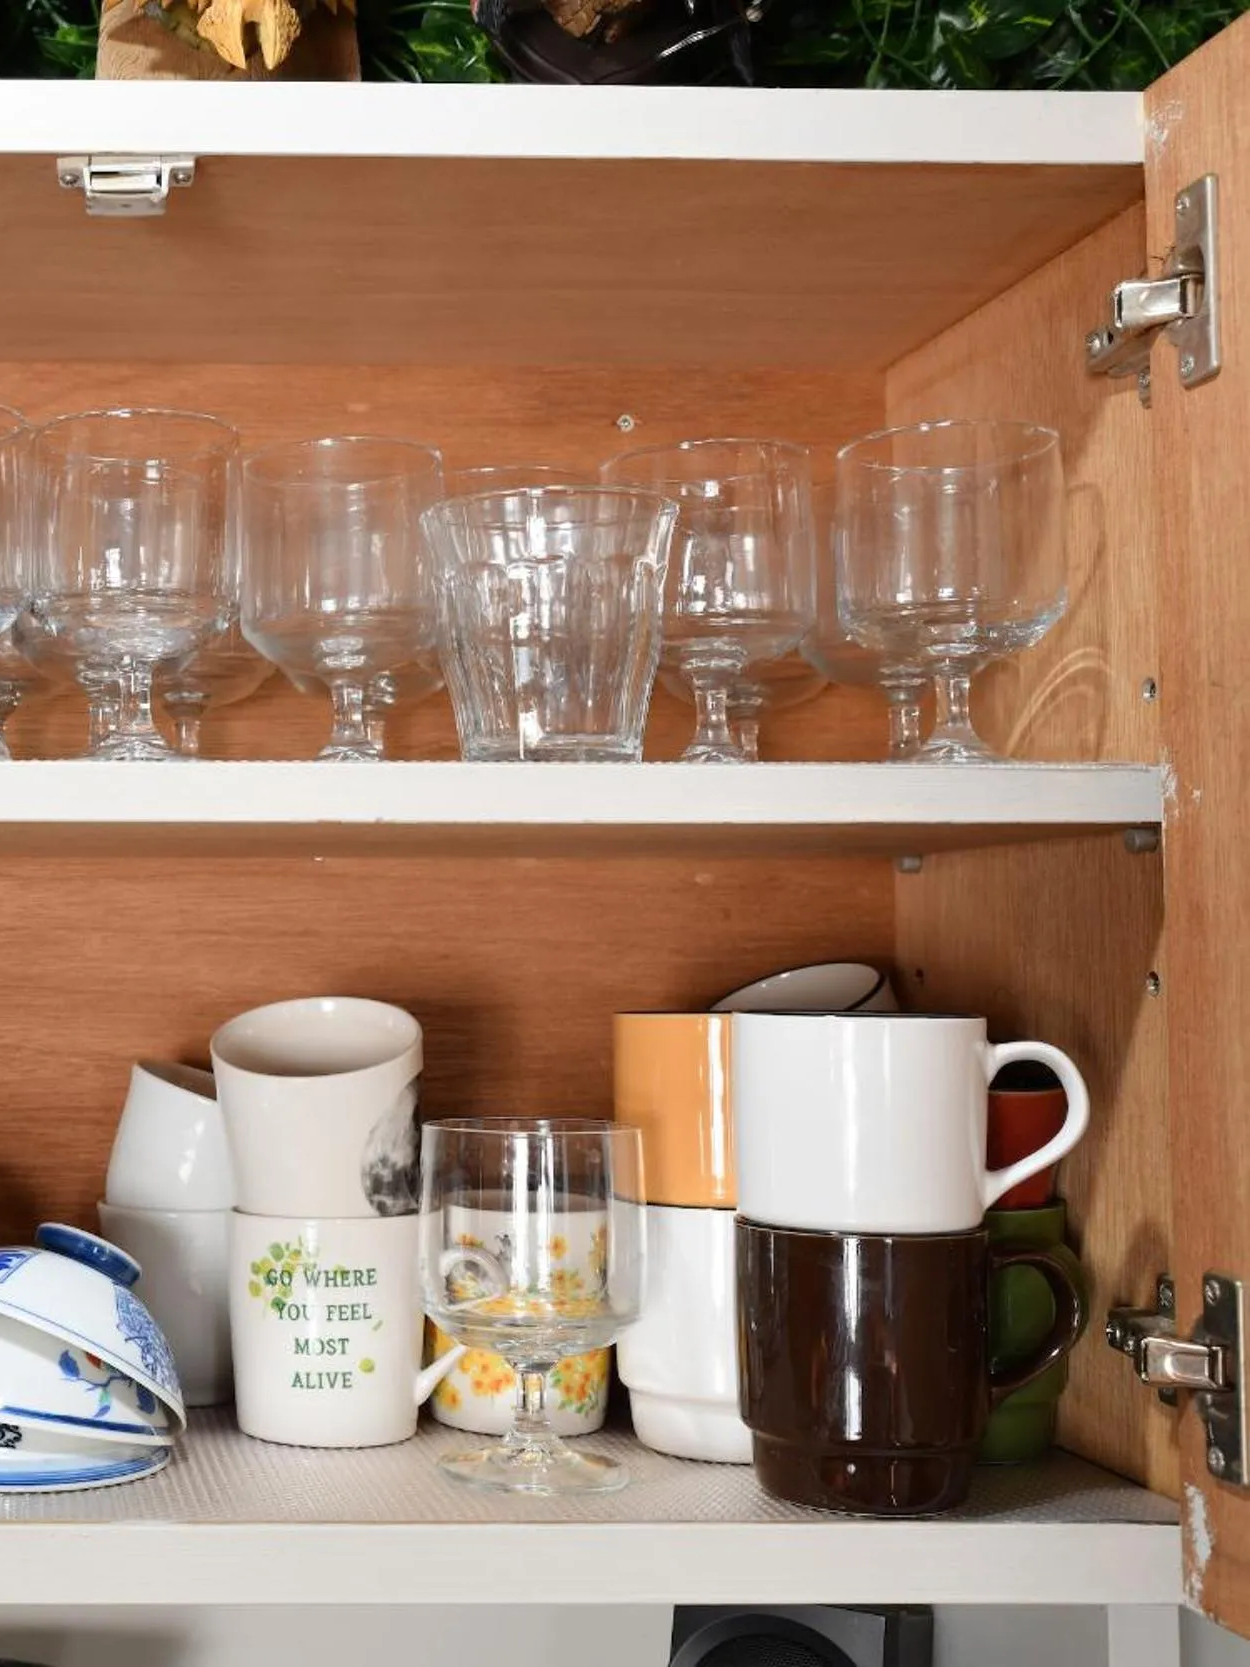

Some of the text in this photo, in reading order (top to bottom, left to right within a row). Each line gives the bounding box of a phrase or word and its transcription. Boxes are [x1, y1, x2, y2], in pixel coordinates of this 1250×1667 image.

[265, 1266, 377, 1288] GO WHERE
[325, 1302, 372, 1321] FEEL
[294, 1337, 349, 1356] MOST
[291, 1371, 353, 1389] ALIVE
